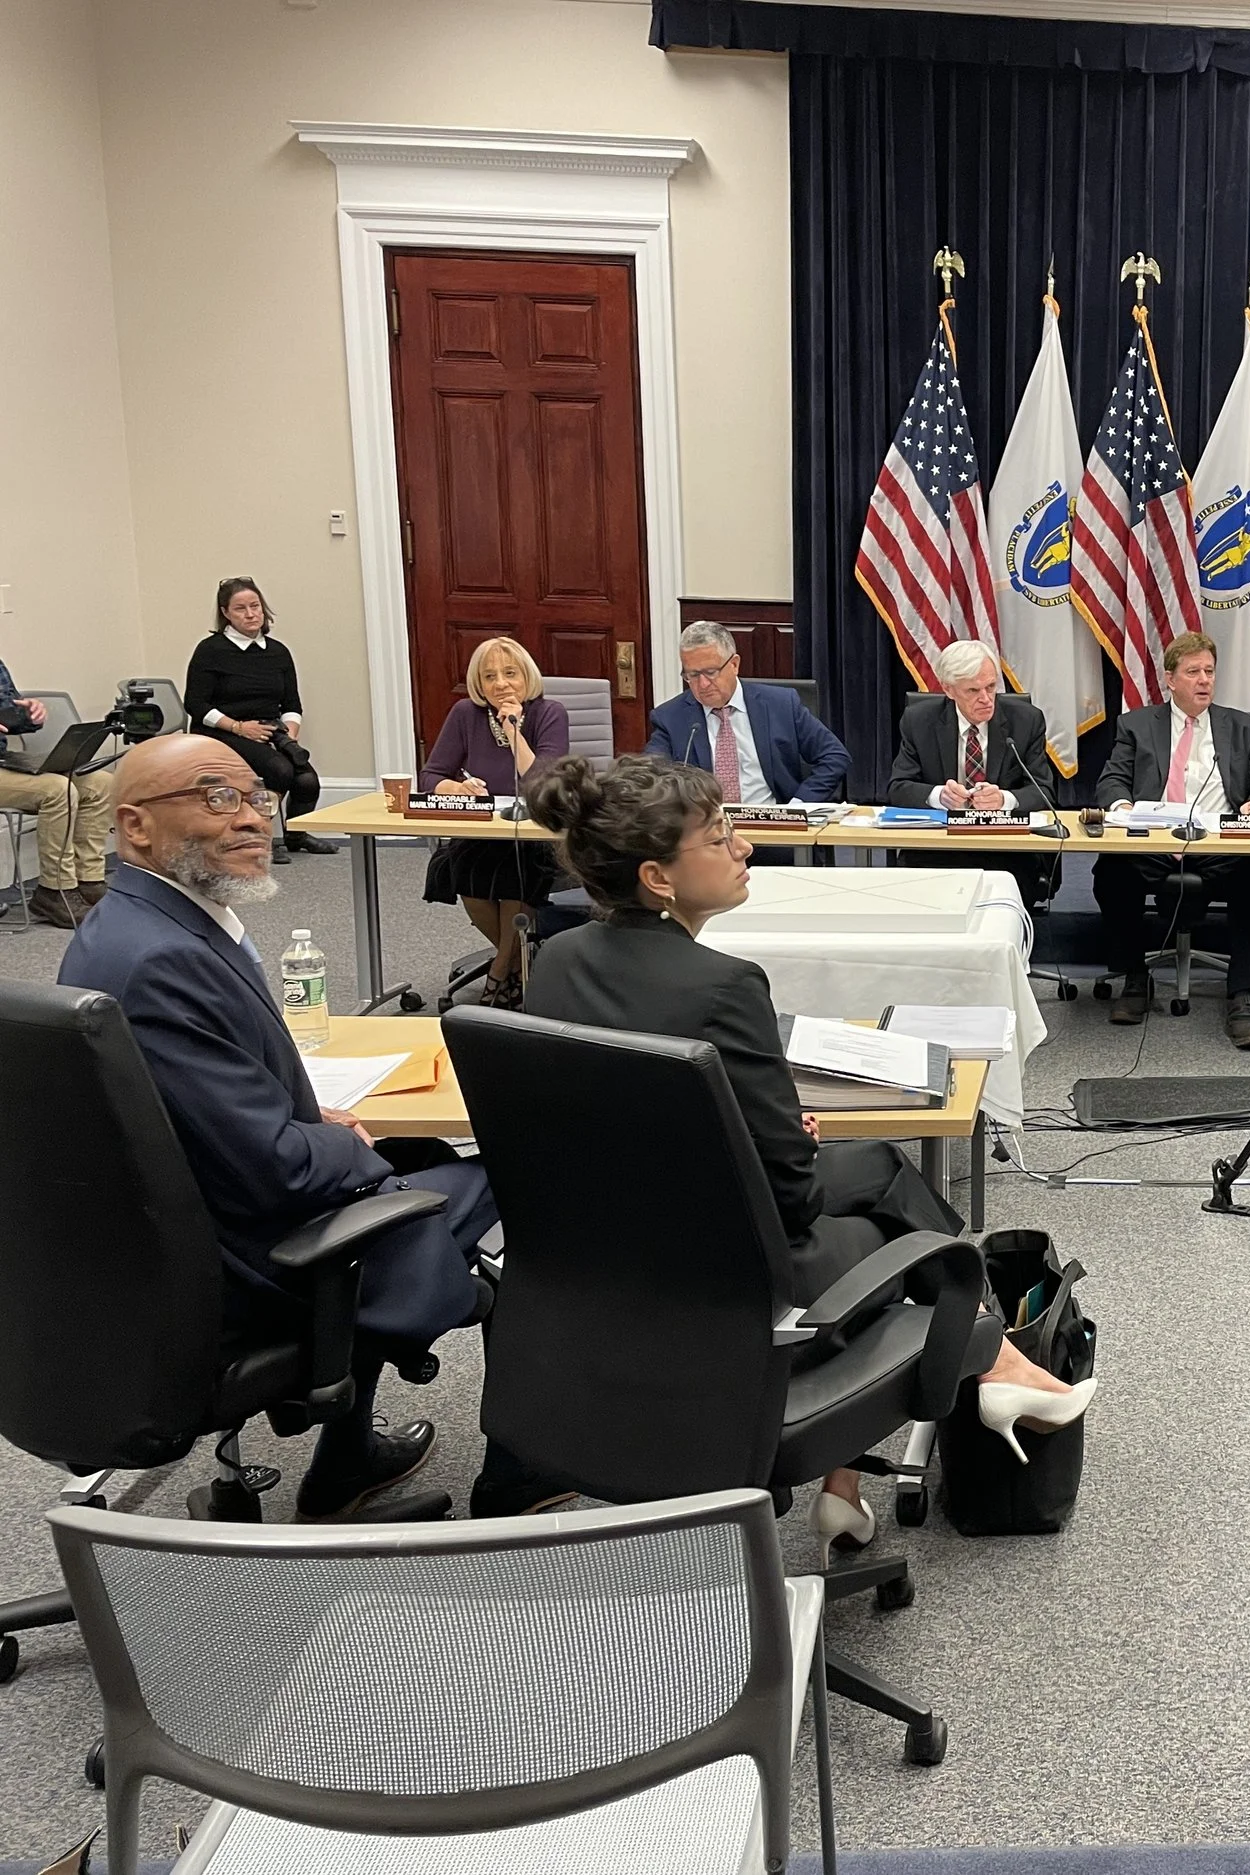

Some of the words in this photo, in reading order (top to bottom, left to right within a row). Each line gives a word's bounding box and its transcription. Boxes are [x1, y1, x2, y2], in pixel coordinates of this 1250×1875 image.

[427, 795, 476, 803] HONORABLE
[409, 801, 436, 809] MARILYN
[465, 803, 494, 811] DEVANEY
[727, 812, 756, 820] OSEPH
[948, 817, 976, 825] ROBERT
